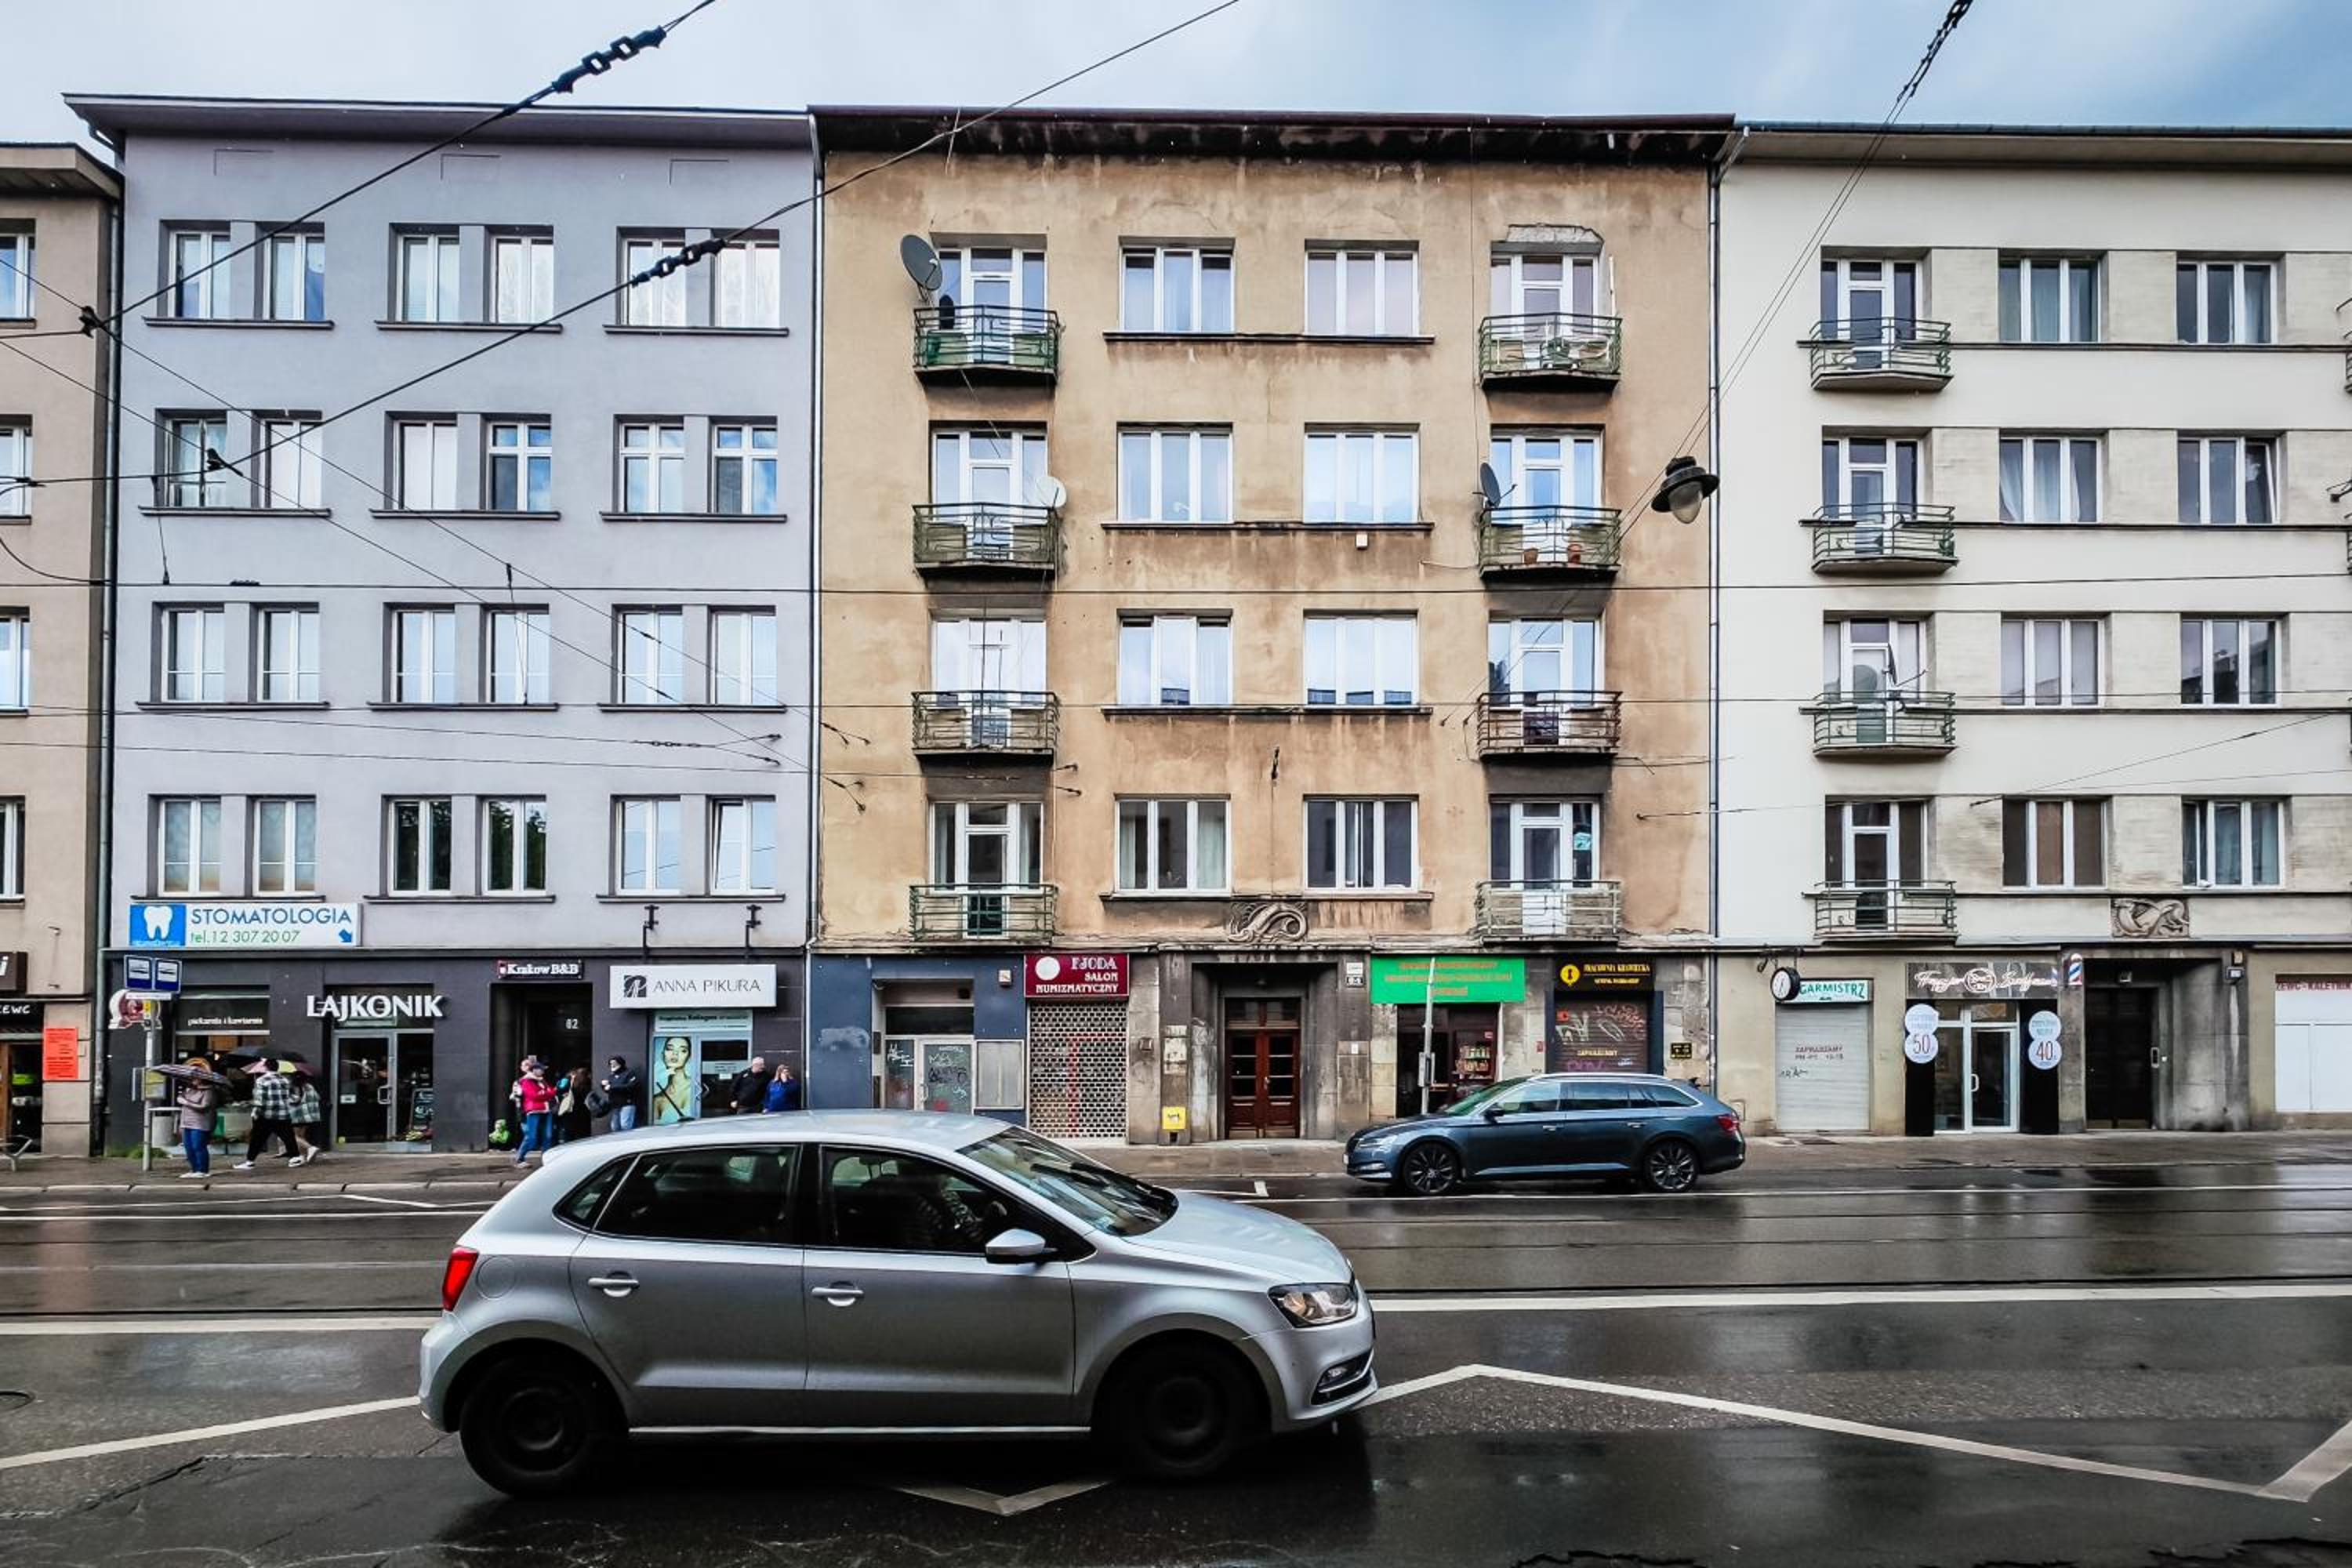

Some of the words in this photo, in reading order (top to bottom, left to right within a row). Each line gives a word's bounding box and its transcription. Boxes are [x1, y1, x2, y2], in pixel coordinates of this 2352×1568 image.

[191, 908, 352, 925] STOMATOLOGIA
[507, 964, 550, 975] Krakow
[550, 964, 579, 975] B&B
[1084, 971, 1119, 982] SALON
[653, 979, 697, 992] ANNA
[702, 979, 761, 992] PIKURA
[1035, 983, 1119, 993] NUMIZMATYCZNY
[1799, 982, 1865, 1000] GARMISTRZ
[307, 994, 444, 1022] LAJKONIK
[1913, 1033, 1931, 1054] 50
[2036, 1040, 2053, 1061] 40
